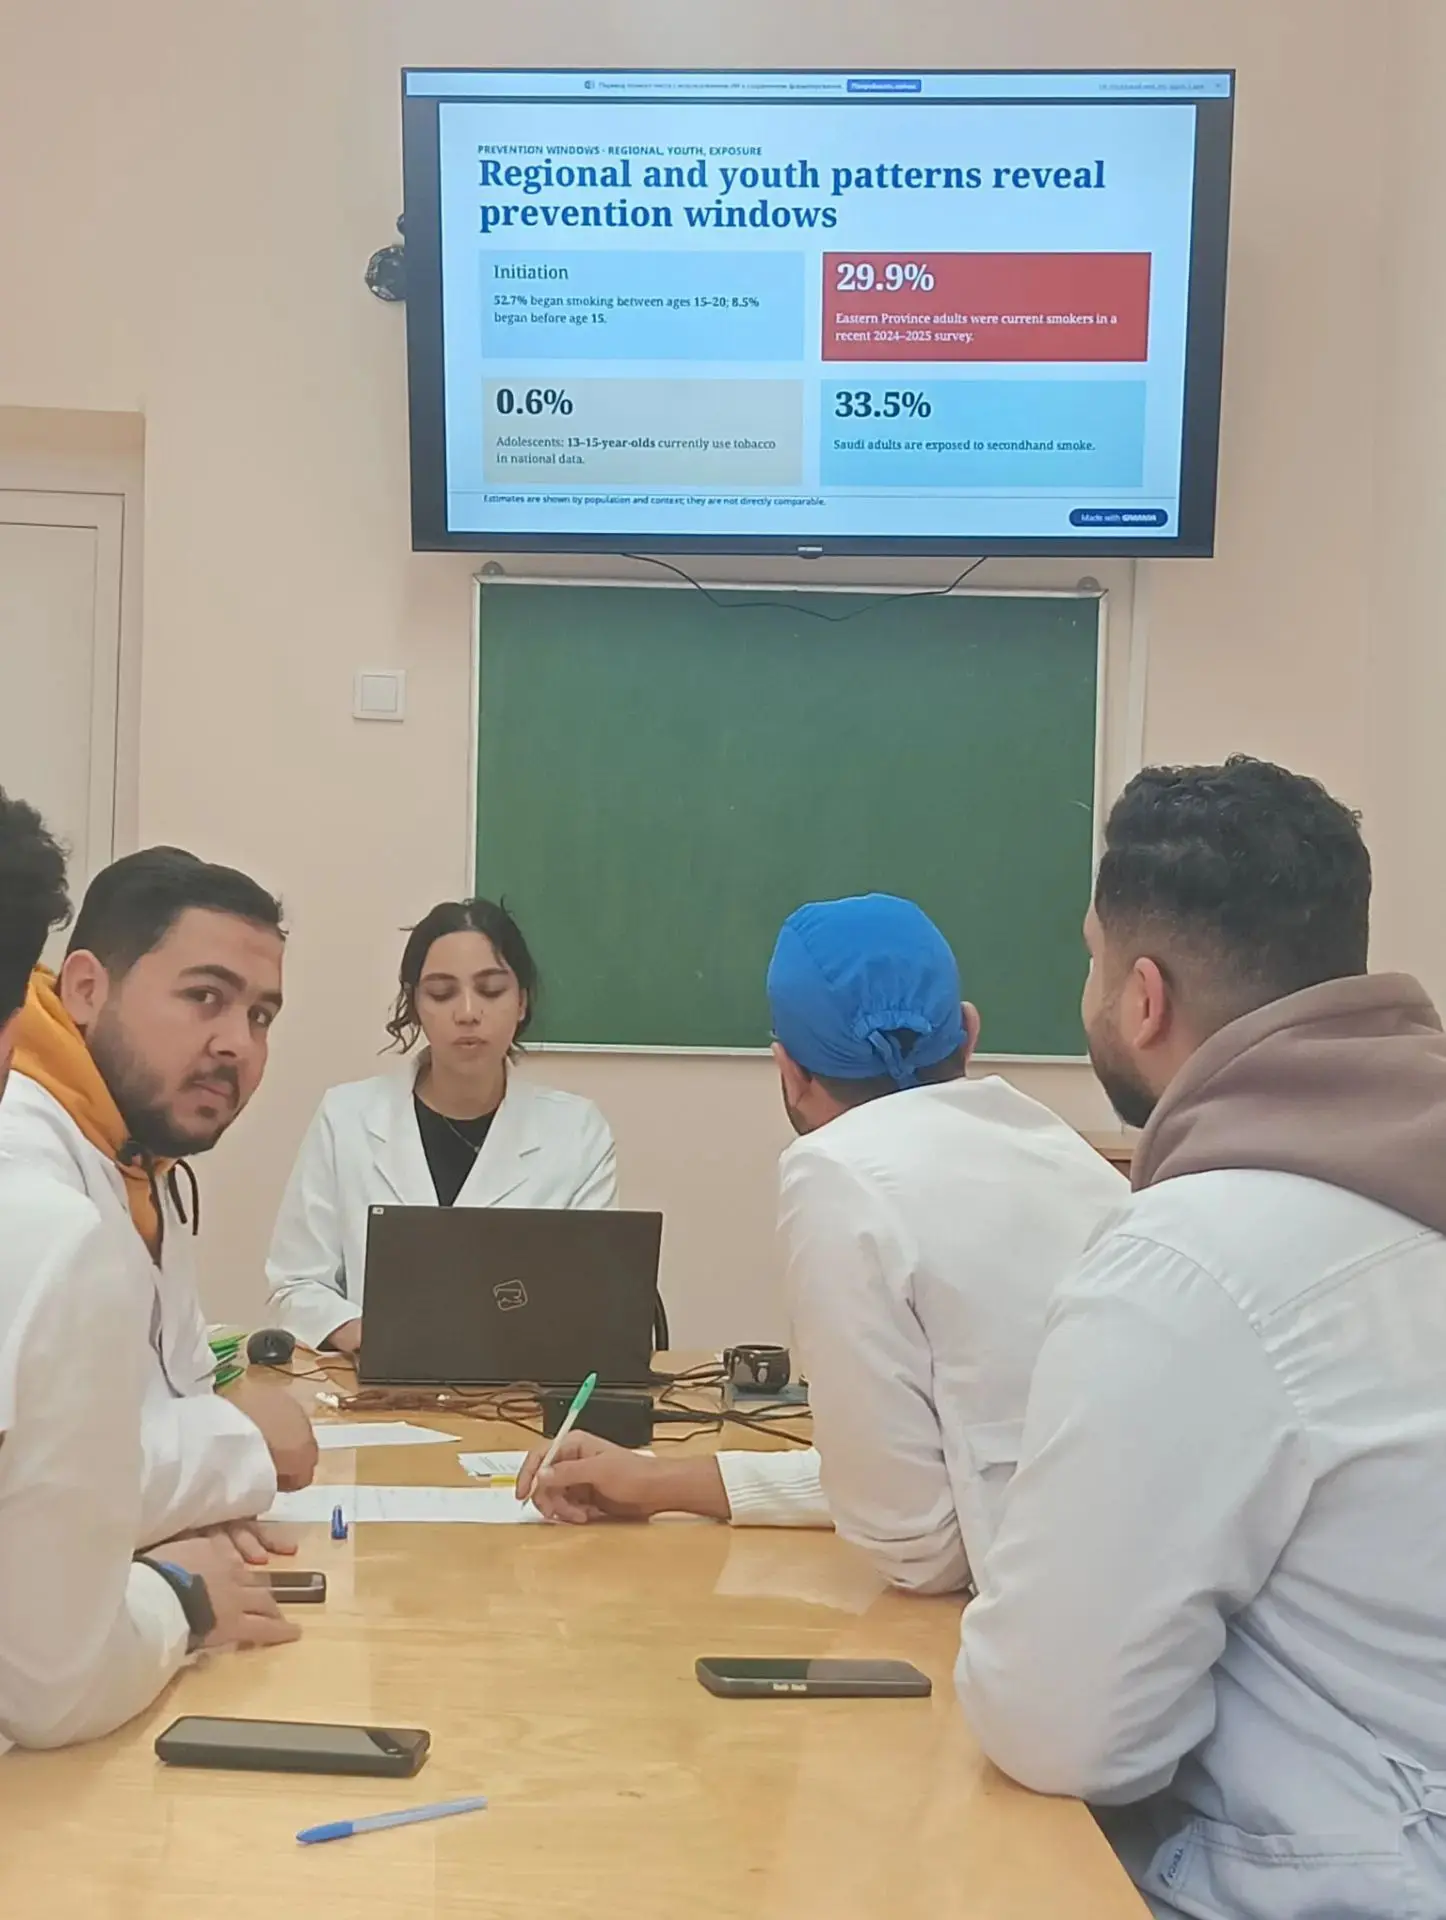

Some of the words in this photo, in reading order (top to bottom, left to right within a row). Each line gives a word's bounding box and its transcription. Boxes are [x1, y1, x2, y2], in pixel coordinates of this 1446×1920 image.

[478, 145, 543, 154] PREVENTION
[546, 145, 600, 154] WINDOWS
[608, 146, 664, 156] REGIONAL,
[668, 146, 706, 156] YOUTH,
[709, 147, 762, 156] EXPOSURE
[479, 159, 631, 194] Regional
[643, 159, 707, 187] and
[719, 160, 820, 195] youth
[831, 163, 982, 196] patterns
[992, 160, 1105, 188] reveal
[480, 200, 672, 232] prevention
[684, 199, 837, 227] windows
[493, 264, 569, 279] Initiation
[836, 263, 935, 291] 29.9%
[493, 295, 528, 306] 52.7%
[530, 296, 564, 307] began
[566, 296, 613, 307] smoking
[617, 296, 664, 306] between
[666, 299, 691, 308] ages
[732, 297, 759, 307] 8.5%
[494, 312, 528, 324] began
[530, 313, 566, 323] before
[569, 314, 589, 325] age
[591, 313, 607, 323] 15.
[835, 313, 878, 324] Eastern
[881, 313, 931, 324] Province
[933, 313, 968, 324] adults
[971, 315, 998, 324] were
[1001, 314, 1044, 324] current
[1046, 313, 1093, 324] smokers
[1096, 314, 1108, 324] in
[1110, 316, 1117, 324] a
[835, 331, 870, 341] recent
[934, 333, 974, 343] survey.
[496, 388, 574, 415] 0.6%
[835, 391, 932, 418] 33.5%
[496, 437, 564, 447] Adolescents:
[658, 438, 709, 450] currently
[712, 440, 731, 448] use
[734, 438, 776, 449] tobacco
[833, 440, 865, 449] Saudi
[868, 440, 902, 450] adults
[904, 442, 922, 450] are
[926, 440, 970, 452] exposed
[973, 441, 984, 450] to
[987, 440, 1053, 451] secondhand
[1057, 441, 1096, 451] smoke.
[496, 453, 508, 463] in
[511, 453, 556, 464] national
[559, 454, 585, 464] data.
[483, 495, 524, 503] Estimates
[543, 495, 570, 503] shown
[572, 495, 583, 505] by
[585, 496, 630, 506] population
[632, 496, 648, 504] and
[687, 496, 706, 506] they
[740, 497, 771, 507] directly
[774, 498, 826, 507] comparable.
